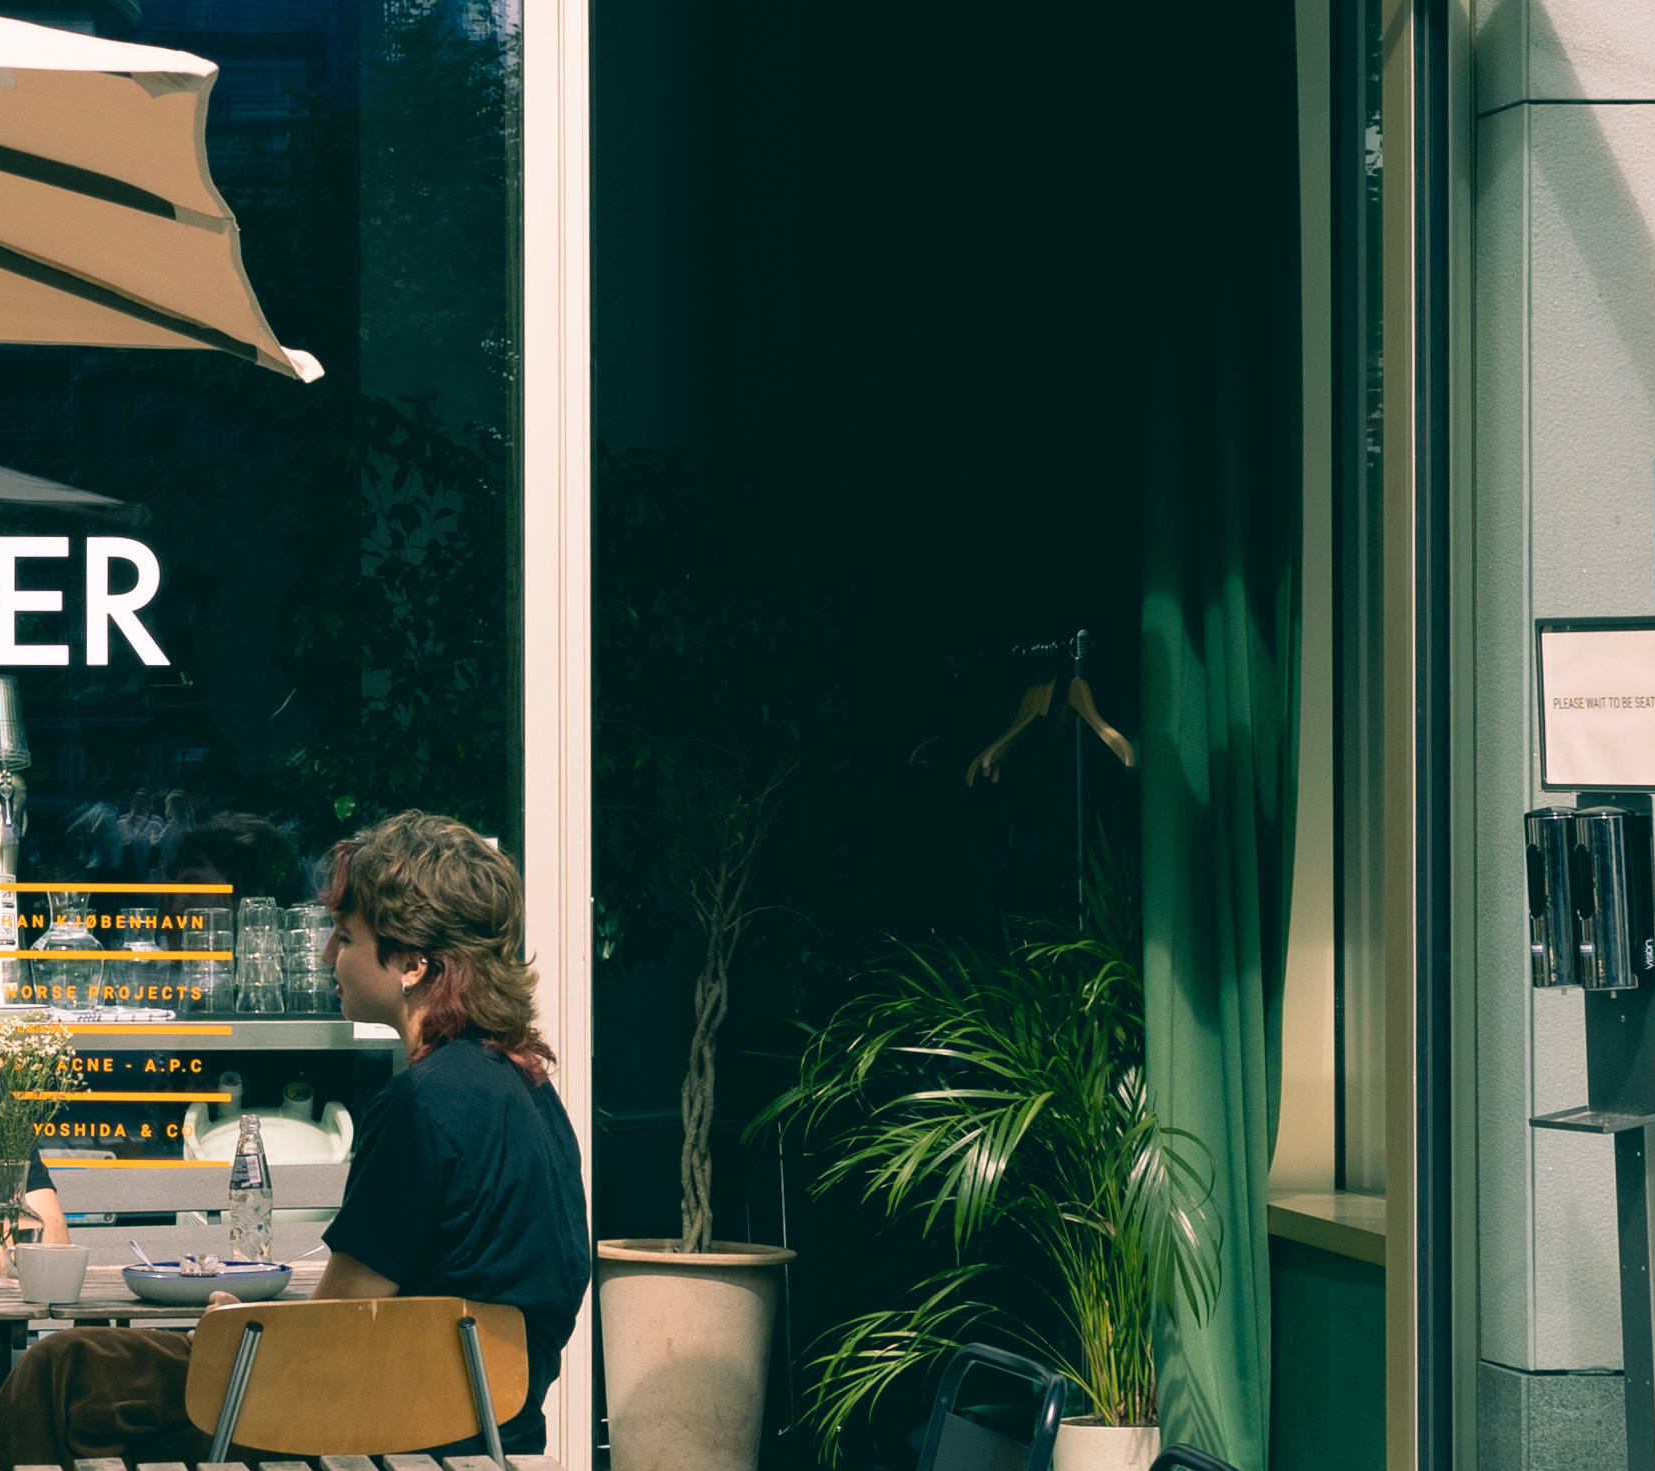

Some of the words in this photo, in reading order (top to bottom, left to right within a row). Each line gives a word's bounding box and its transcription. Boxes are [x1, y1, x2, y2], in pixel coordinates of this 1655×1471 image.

[1553, 697, 1584, 709] PLEASE
[1586, 696, 1606, 709] WAIT
[1609, 696, 1620, 709] TO
[1622, 696, 1633, 709] BE
[56, 914, 204, 930] KJØBENHAVN
[4, 984, 77, 1001] NORSE
[88, 984, 202, 1001] PROJECTS
[56, 1057, 114, 1073] ACNE
[144, 1058, 202, 1073] A.P.C
[33, 1122, 126, 1137] YOSHIDA
[140, 1123, 152, 1138] &
[166, 1123, 194, 1138] CO
